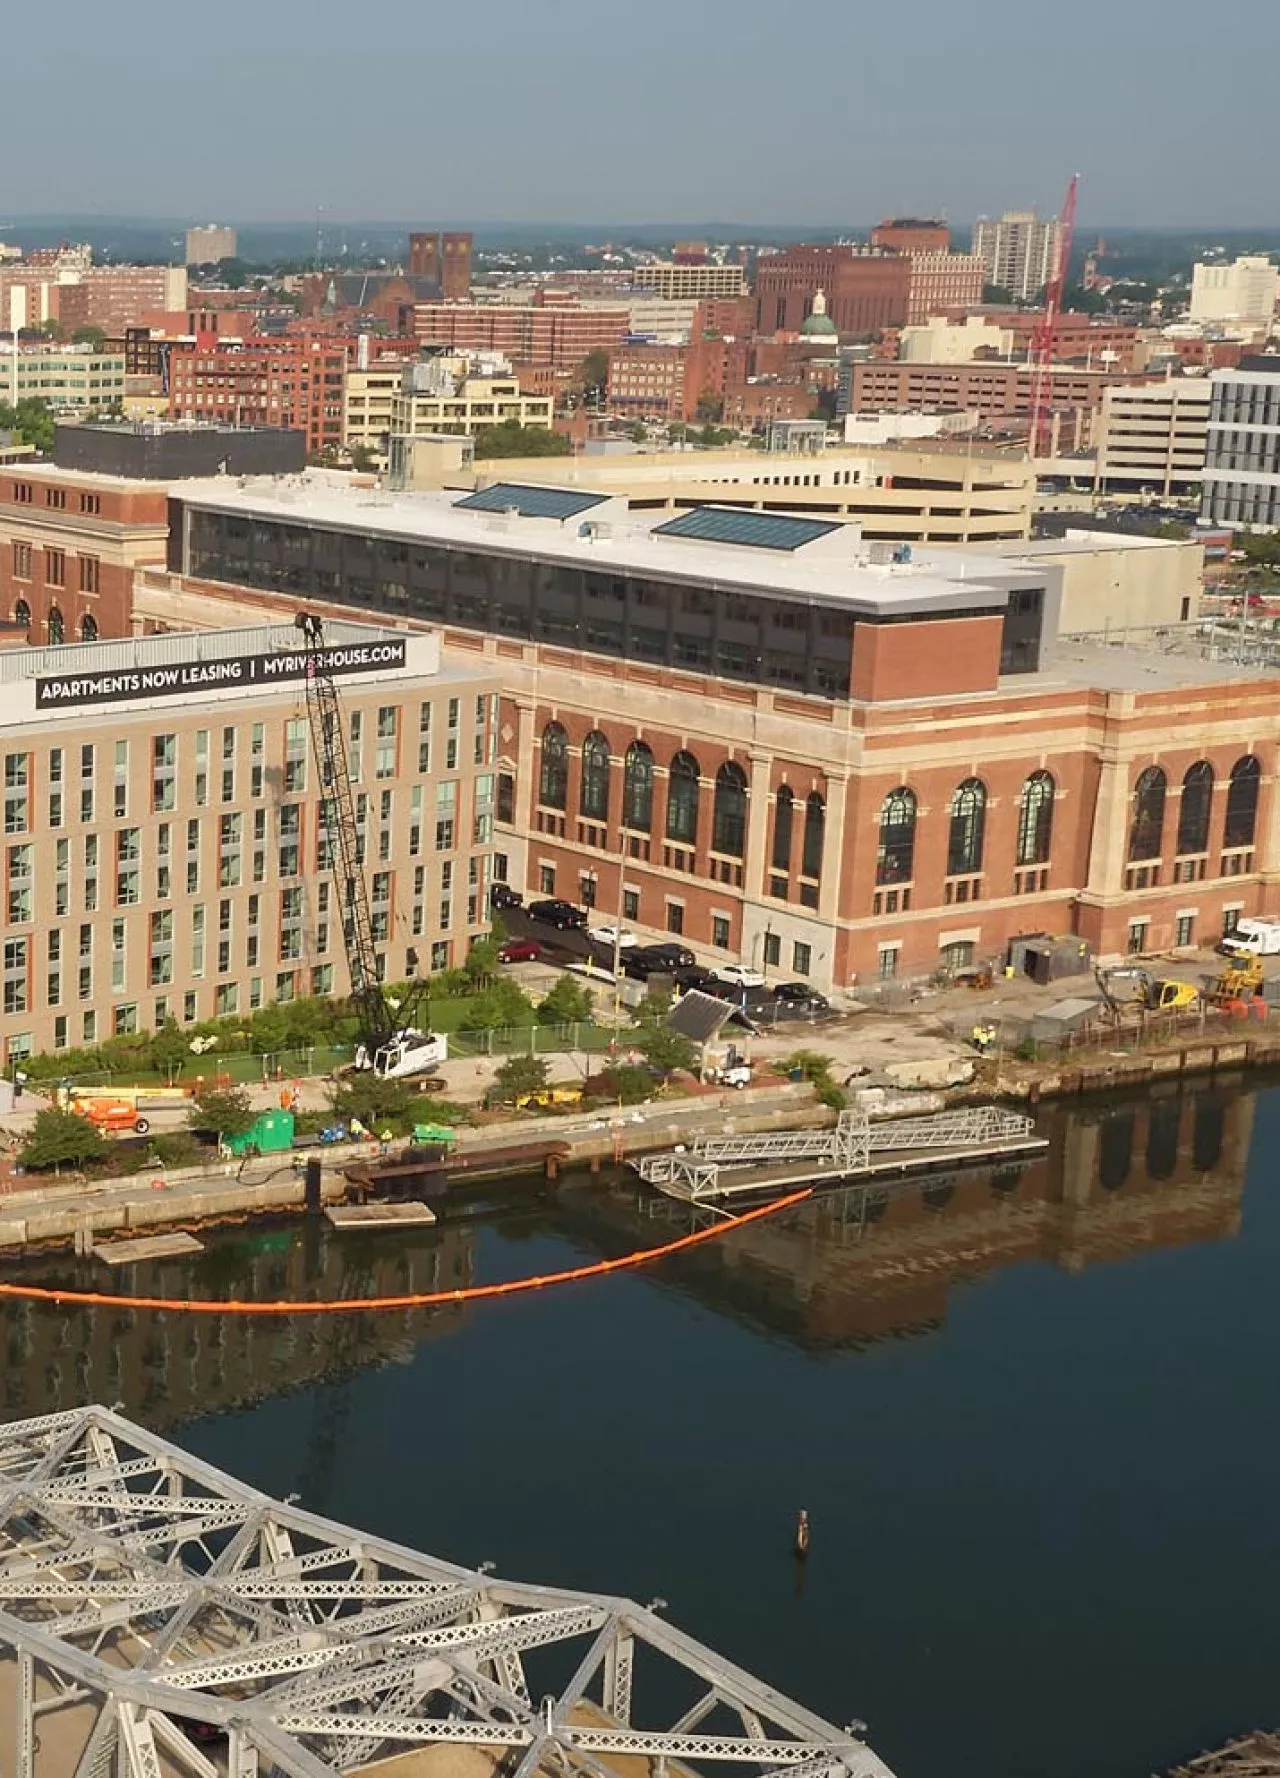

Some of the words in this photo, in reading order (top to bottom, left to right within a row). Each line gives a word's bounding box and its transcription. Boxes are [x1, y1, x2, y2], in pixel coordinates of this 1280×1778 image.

[41, 674, 140, 700] APARTMENTS
[142, 667, 180, 688] NOW
[182, 663, 242, 686] LEASING
[264, 646, 403, 674] MYRIVRHOUSE.COM
